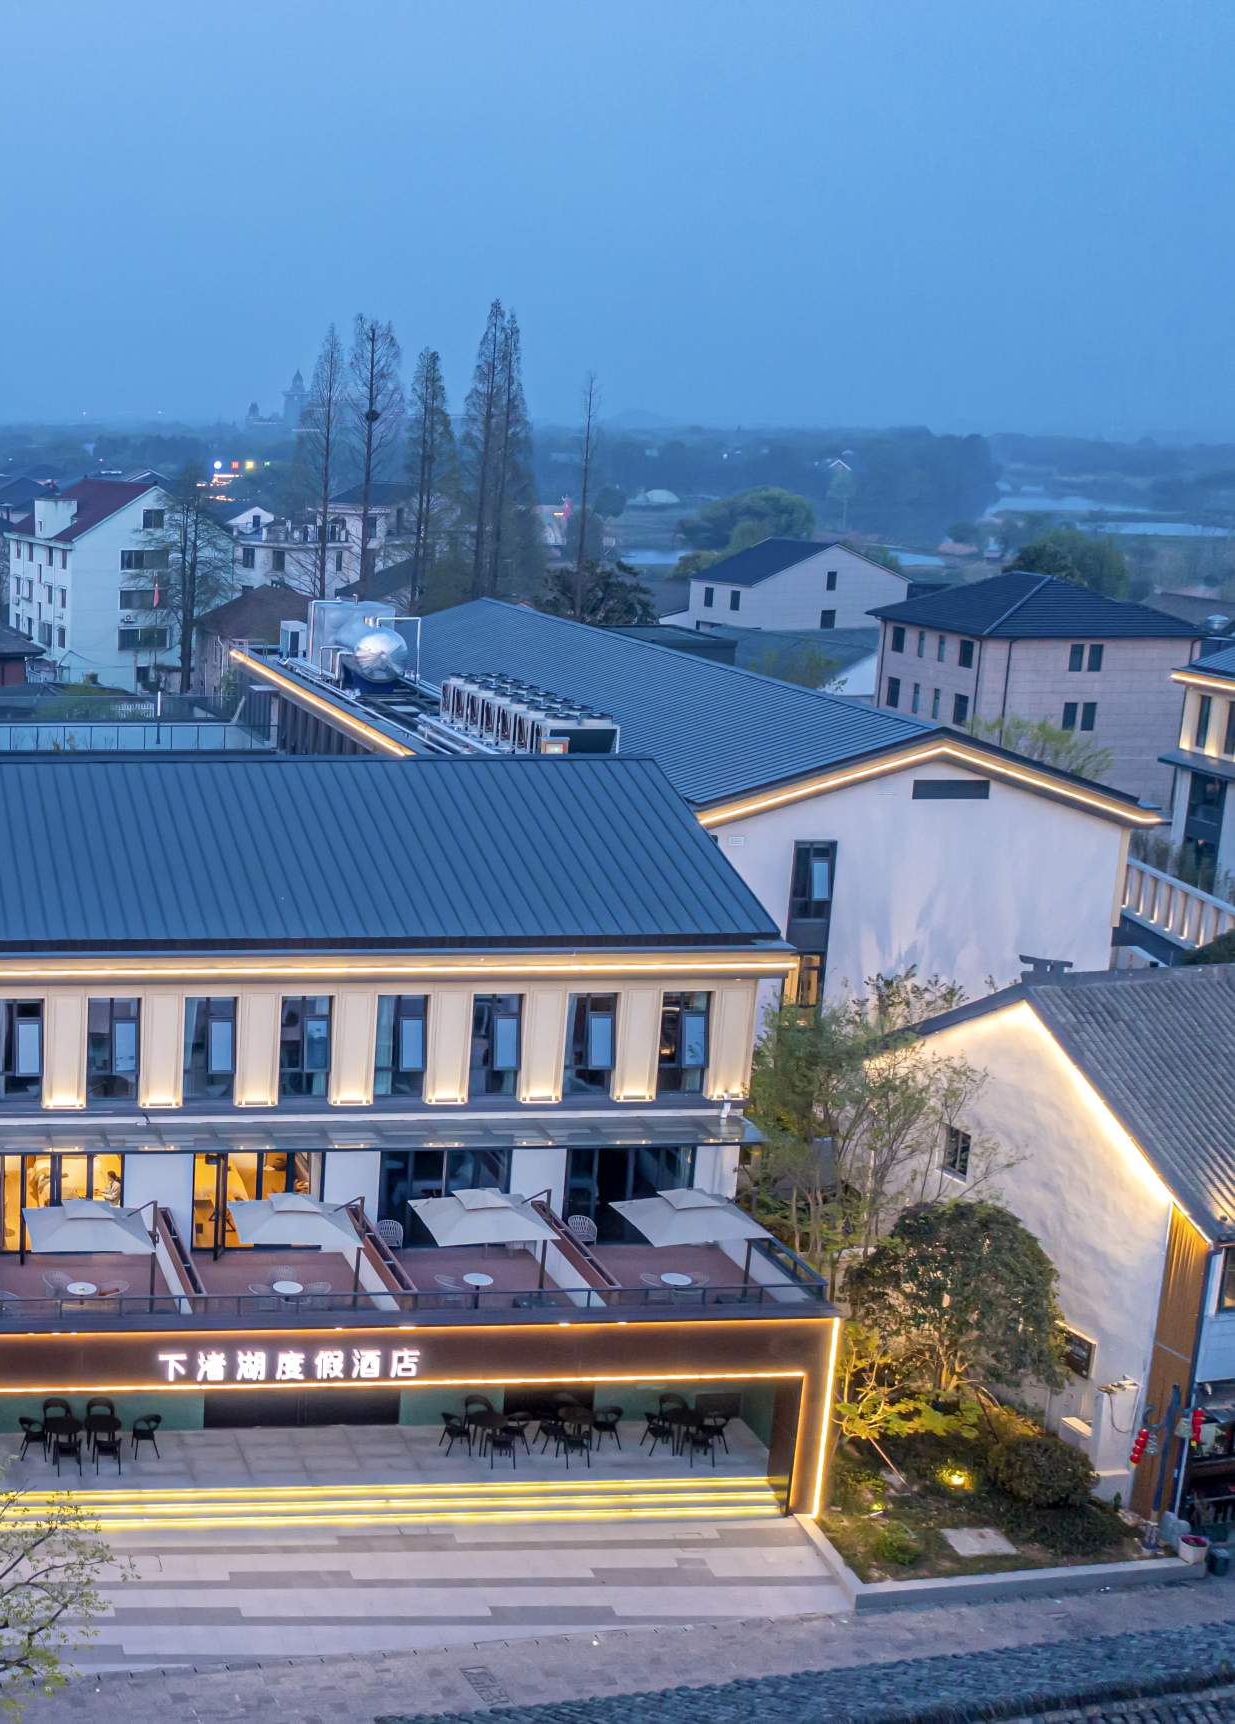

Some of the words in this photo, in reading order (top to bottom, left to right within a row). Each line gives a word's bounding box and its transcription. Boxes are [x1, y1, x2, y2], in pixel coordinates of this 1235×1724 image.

[158, 1348, 420, 1381] 下渚湖度假酒店
